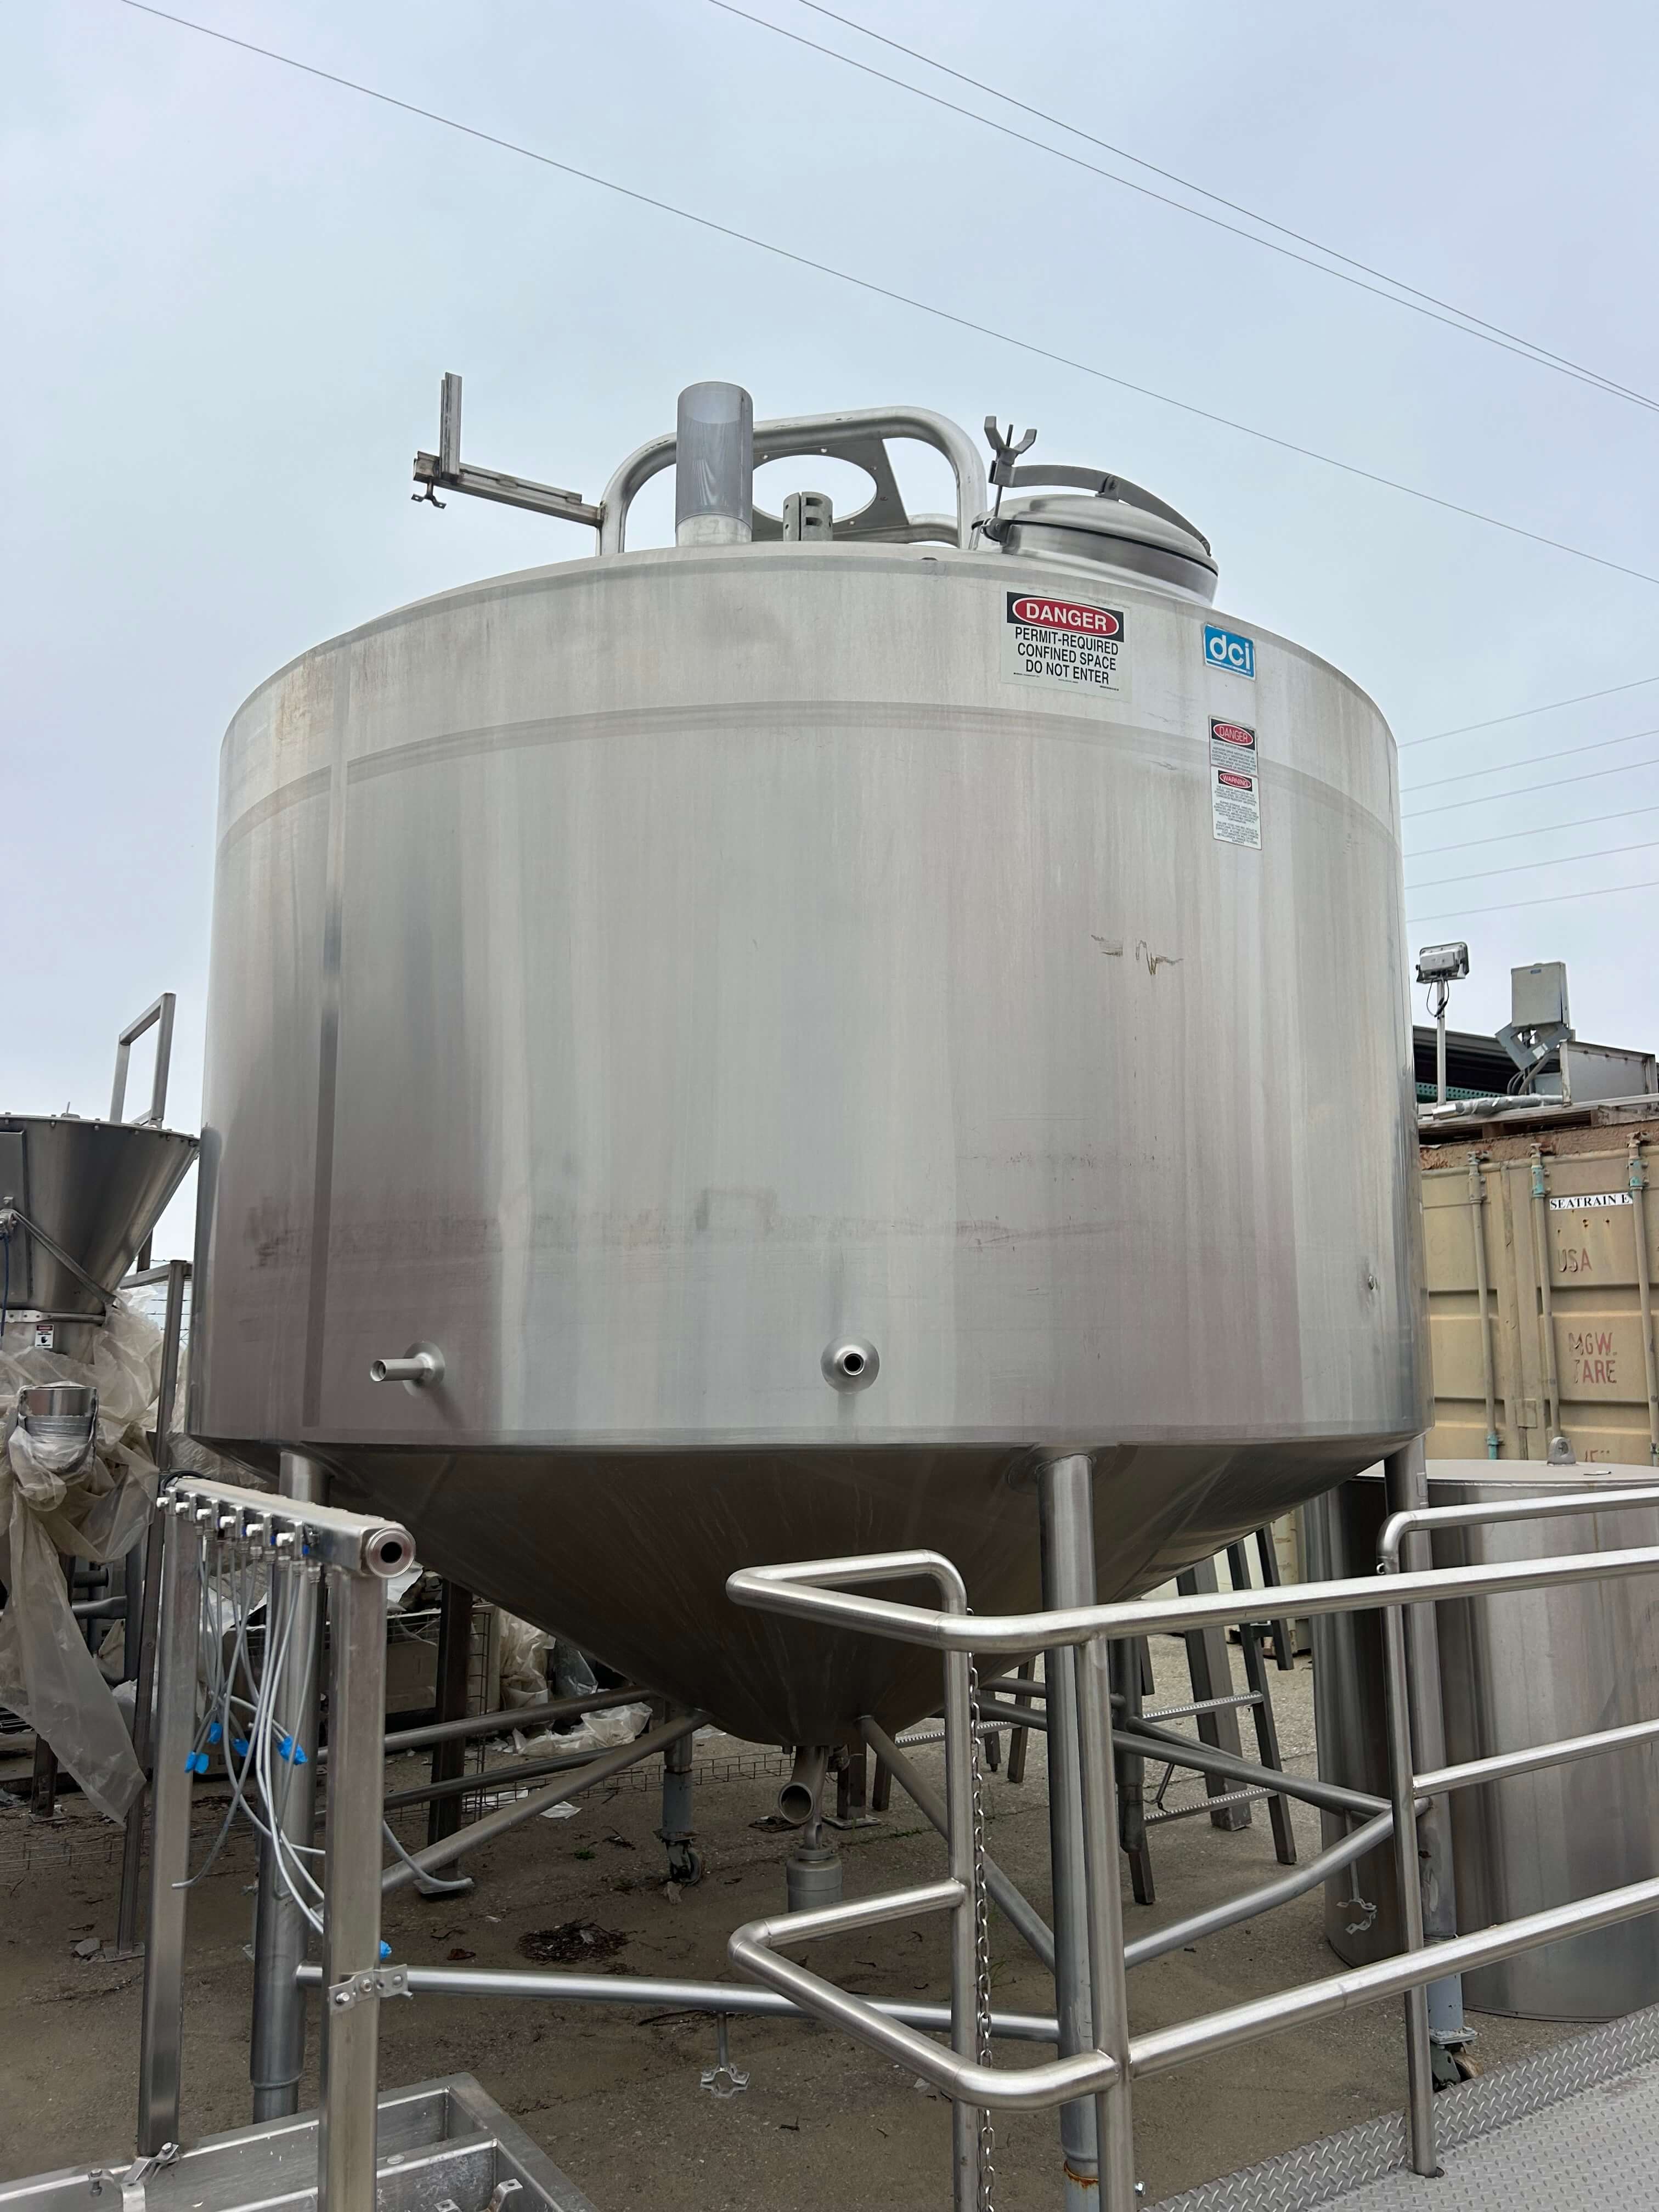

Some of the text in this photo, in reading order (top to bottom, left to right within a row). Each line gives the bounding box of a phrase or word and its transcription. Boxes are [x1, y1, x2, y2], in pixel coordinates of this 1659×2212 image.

[1026, 602, 1107, 631] DANGER
[1015, 627, 1118, 656] PERMIT-REQUIRED
[1210, 634, 1250, 669] dci
[1018, 642, 1116, 671] CONFINED SPACE
[1026, 659, 1109, 685] DO NOT ENTER
[1219, 726, 1248, 743] DANGER
[1223, 774, 1248, 787] WARNING
[1550, 1195, 1616, 1209] SEATRAIN
[1558, 1248, 1593, 1272] USA
